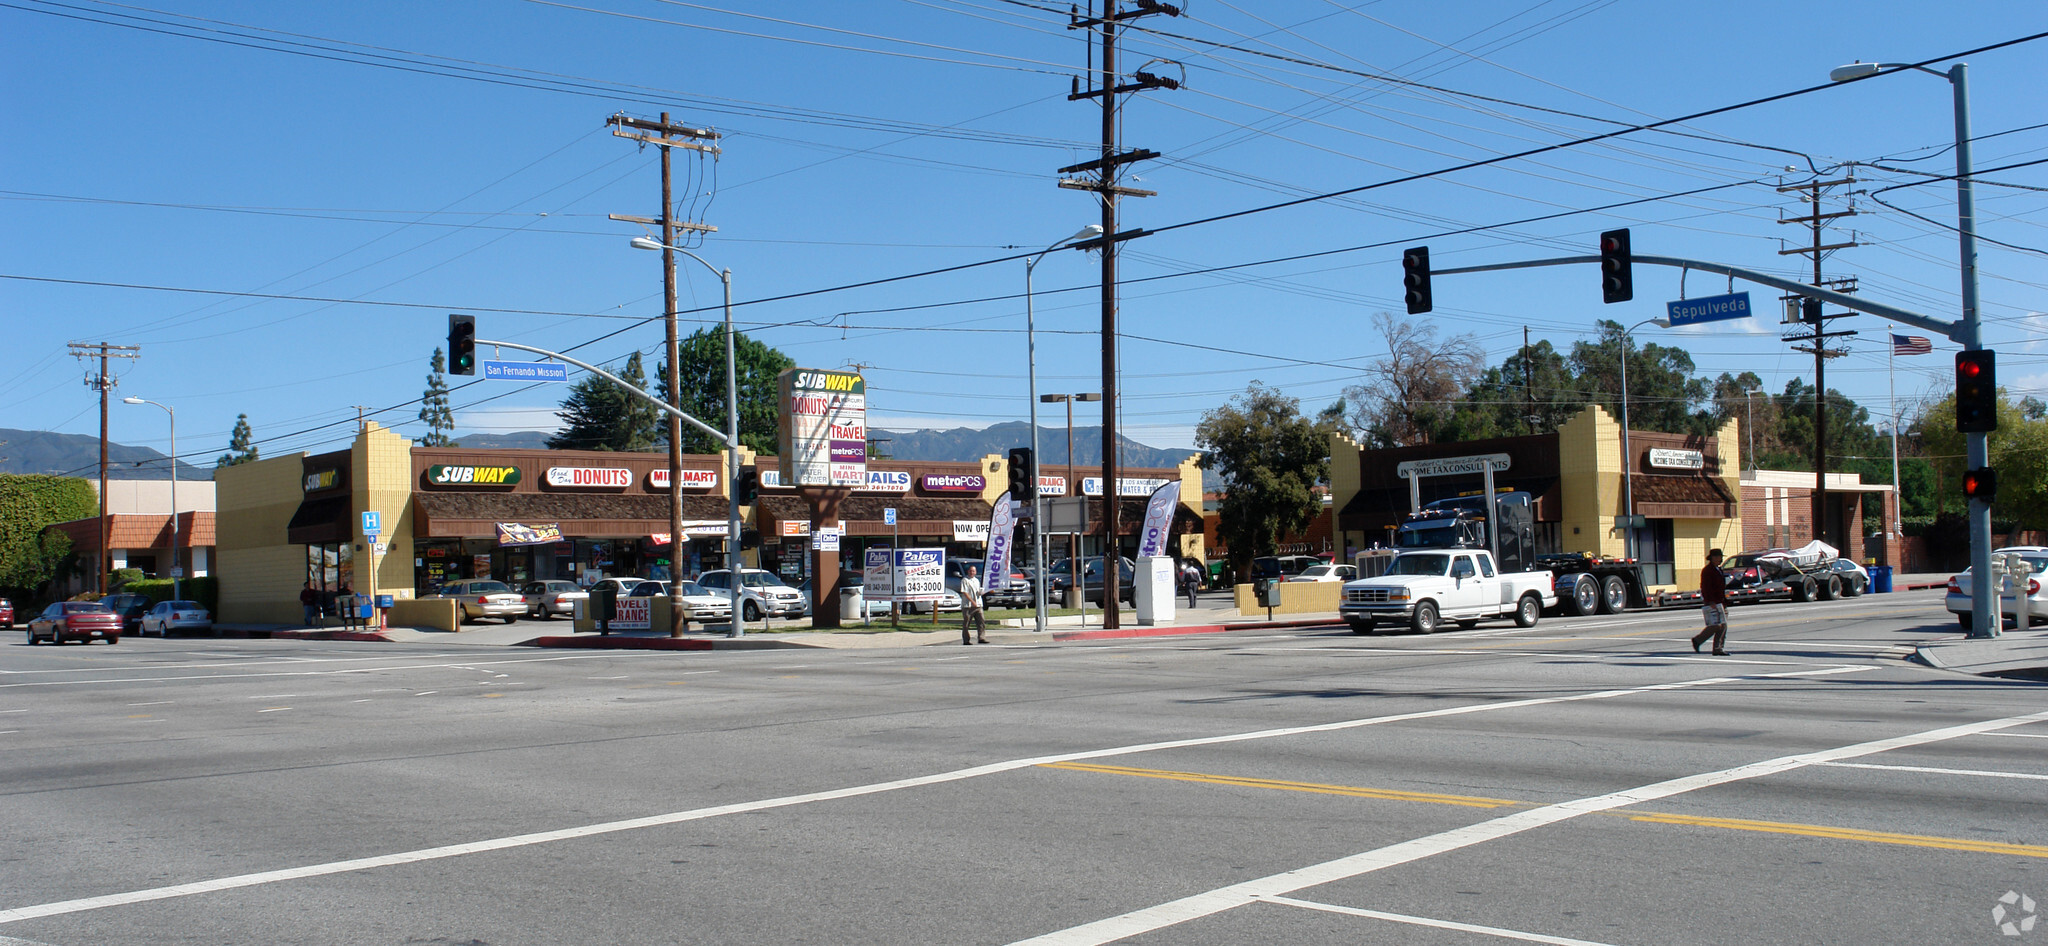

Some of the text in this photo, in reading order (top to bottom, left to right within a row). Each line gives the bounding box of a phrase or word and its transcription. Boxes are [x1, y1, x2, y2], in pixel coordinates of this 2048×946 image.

[1672, 299, 1746, 319] Sepulveda
[487, 365, 564, 377] San Fernando Mission
[794, 372, 861, 391] SUBWAY
[792, 396, 828, 415] DONUTS
[830, 424, 865, 440] TRAVEL
[831, 448, 864, 456] metroPCS
[436, 466, 515, 483] SUBWAY
[654, 471, 716, 482] MI MART
[833, 471, 865, 480] MART
[1400, 467, 1432, 477] INOME
[1433, 464, 1450, 474] TAX
[305, 469, 336, 491] SUBWAY
[573, 469, 628, 485] DONUTS
[866, 472, 909, 484] AILS
[927, 475, 981, 487] metroPCS
[1123, 486, 1141, 494] WATER
[366, 514, 377, 527] H
[955, 524, 990, 533] NOW OPE
[1142, 498, 1167, 557] troPCS
[988, 502, 1010, 589] metroPCS
[869, 552, 889, 562] Paley
[902, 551, 938, 562] Paley
[907, 582, 942, 592] 343-3000
[616, 600, 648, 608] AVEL &
[617, 609, 649, 621] RANCE
